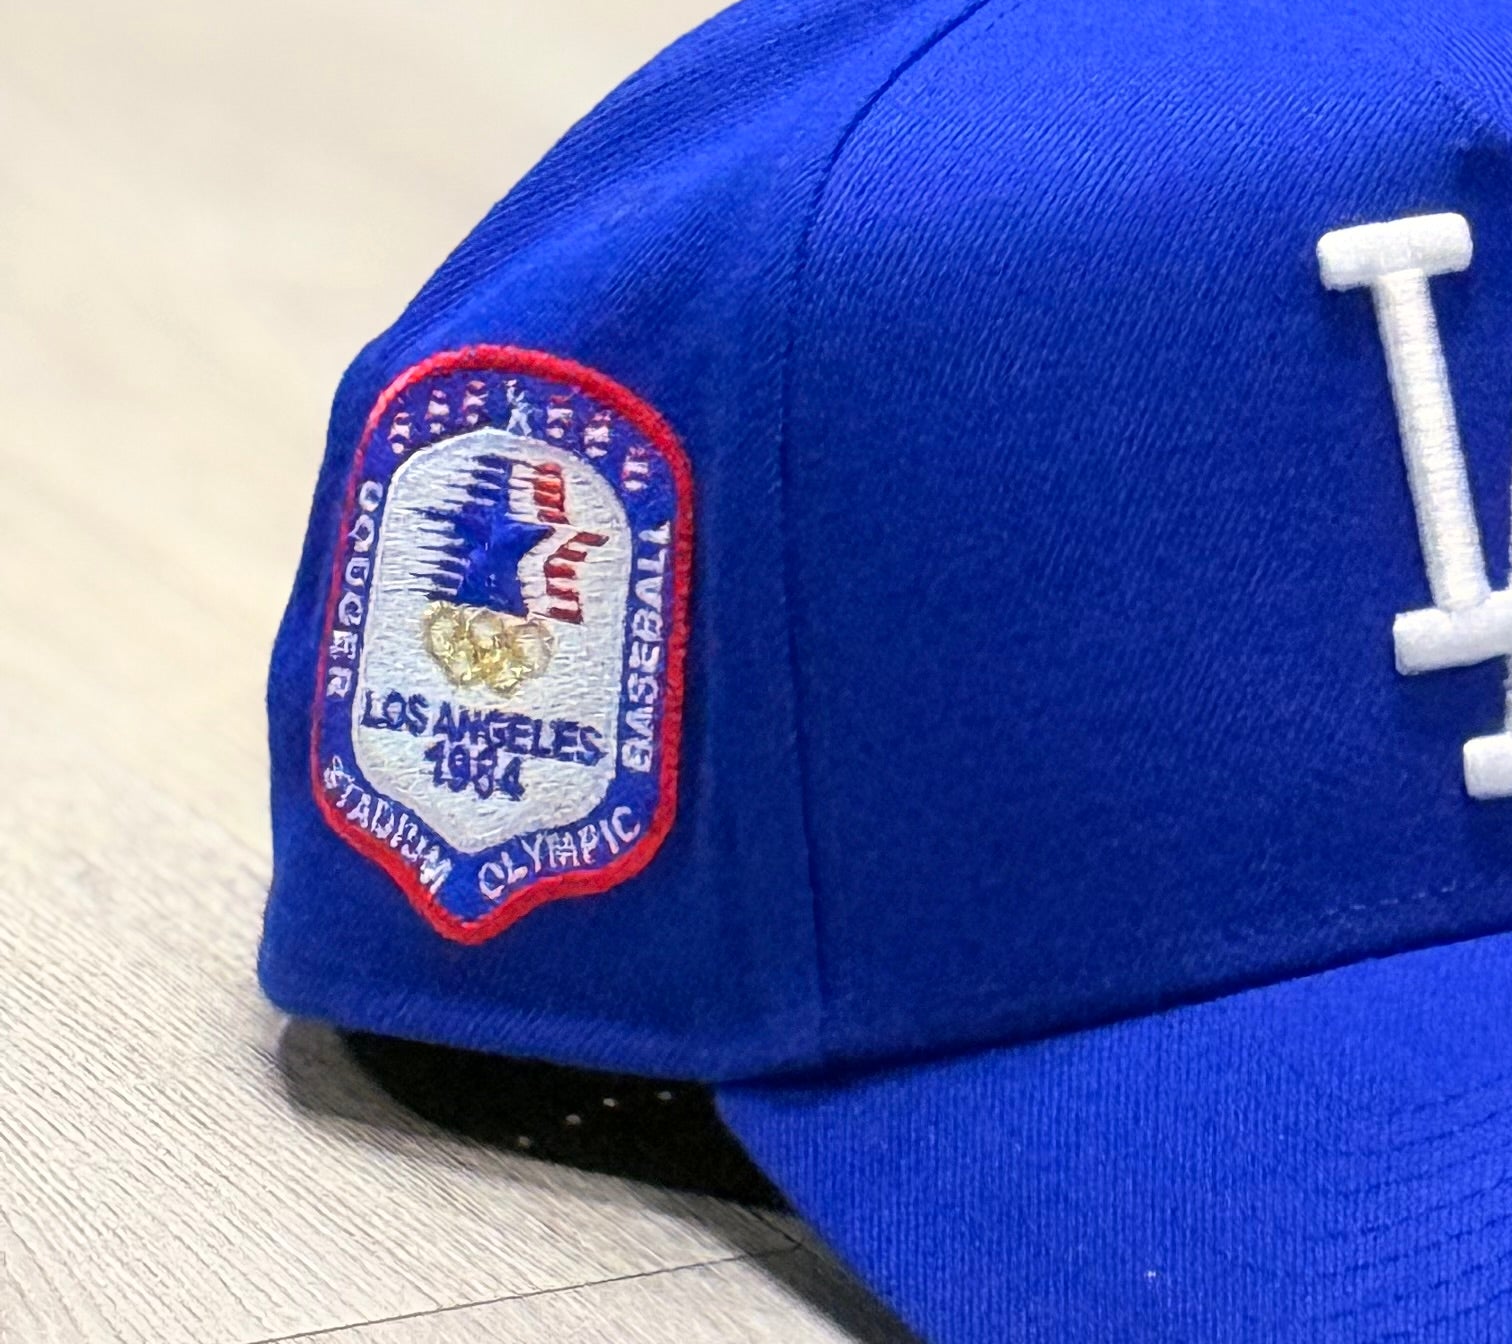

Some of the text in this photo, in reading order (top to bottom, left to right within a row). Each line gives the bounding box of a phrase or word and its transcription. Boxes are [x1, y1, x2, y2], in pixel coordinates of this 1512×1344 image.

[620, 519, 671, 775] BASEBALL
[360, 687, 608, 766] LOS ANGELES
[323, 755, 453, 895] STADIUM
[478, 805, 642, 900] OLYMPIC
